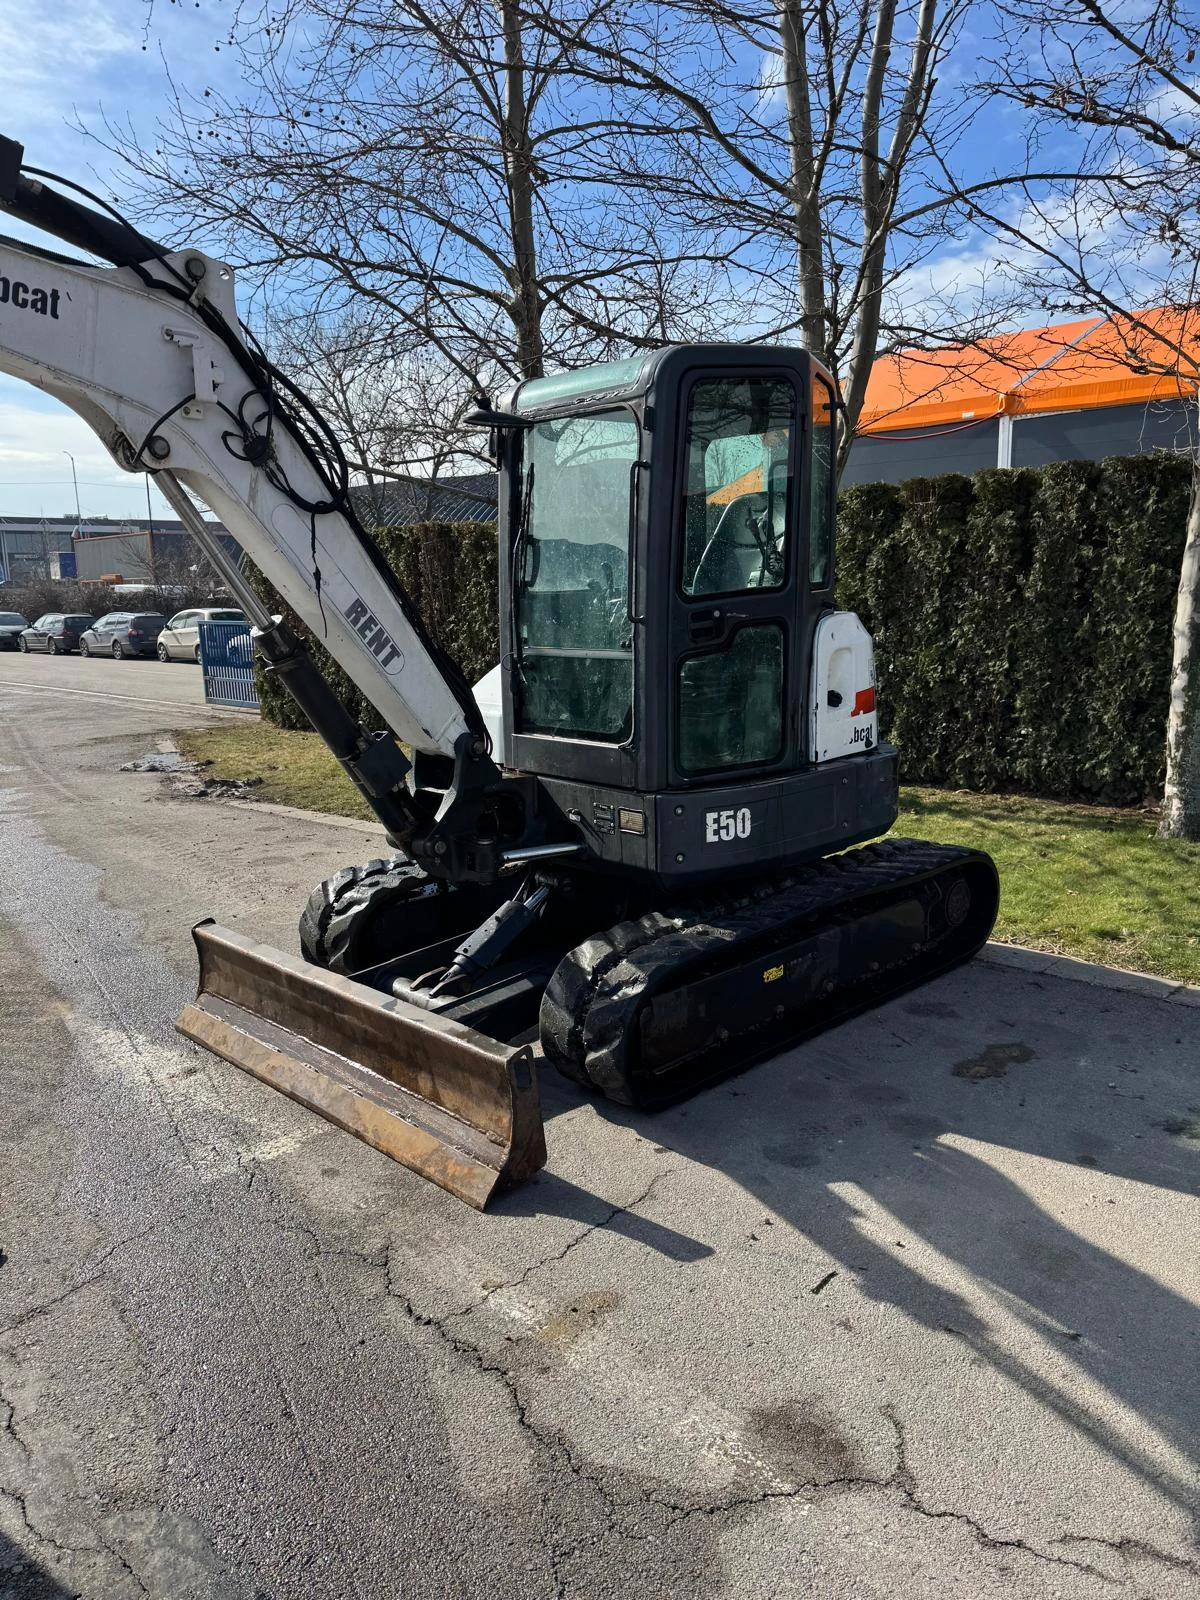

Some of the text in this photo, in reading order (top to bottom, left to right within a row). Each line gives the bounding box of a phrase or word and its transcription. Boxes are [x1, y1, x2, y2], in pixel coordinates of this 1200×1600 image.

[344, 597, 401, 668] RENT
[849, 723, 873, 745] bcat
[706, 807, 752, 843] E50
